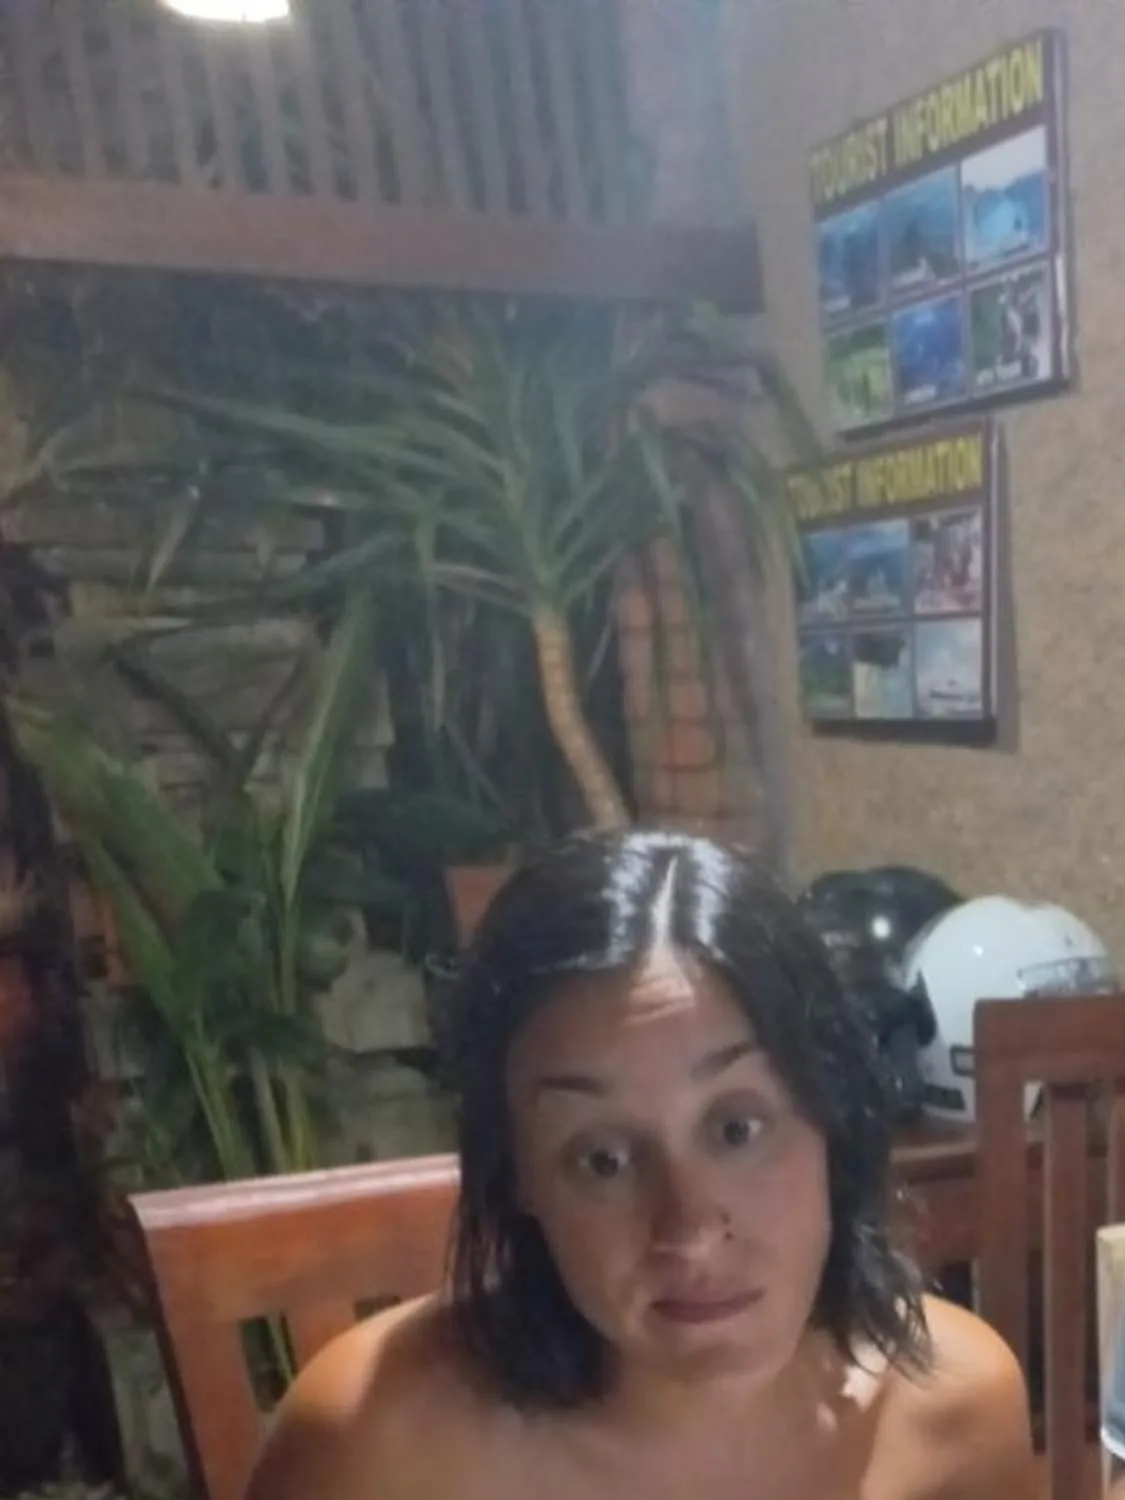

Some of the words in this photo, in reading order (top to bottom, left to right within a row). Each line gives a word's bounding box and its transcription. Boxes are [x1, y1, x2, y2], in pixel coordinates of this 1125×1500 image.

[808, 117, 888, 202] TOURIST
[893, 37, 1043, 168] INFORMATION
[856, 434, 981, 507] INFORMATION
